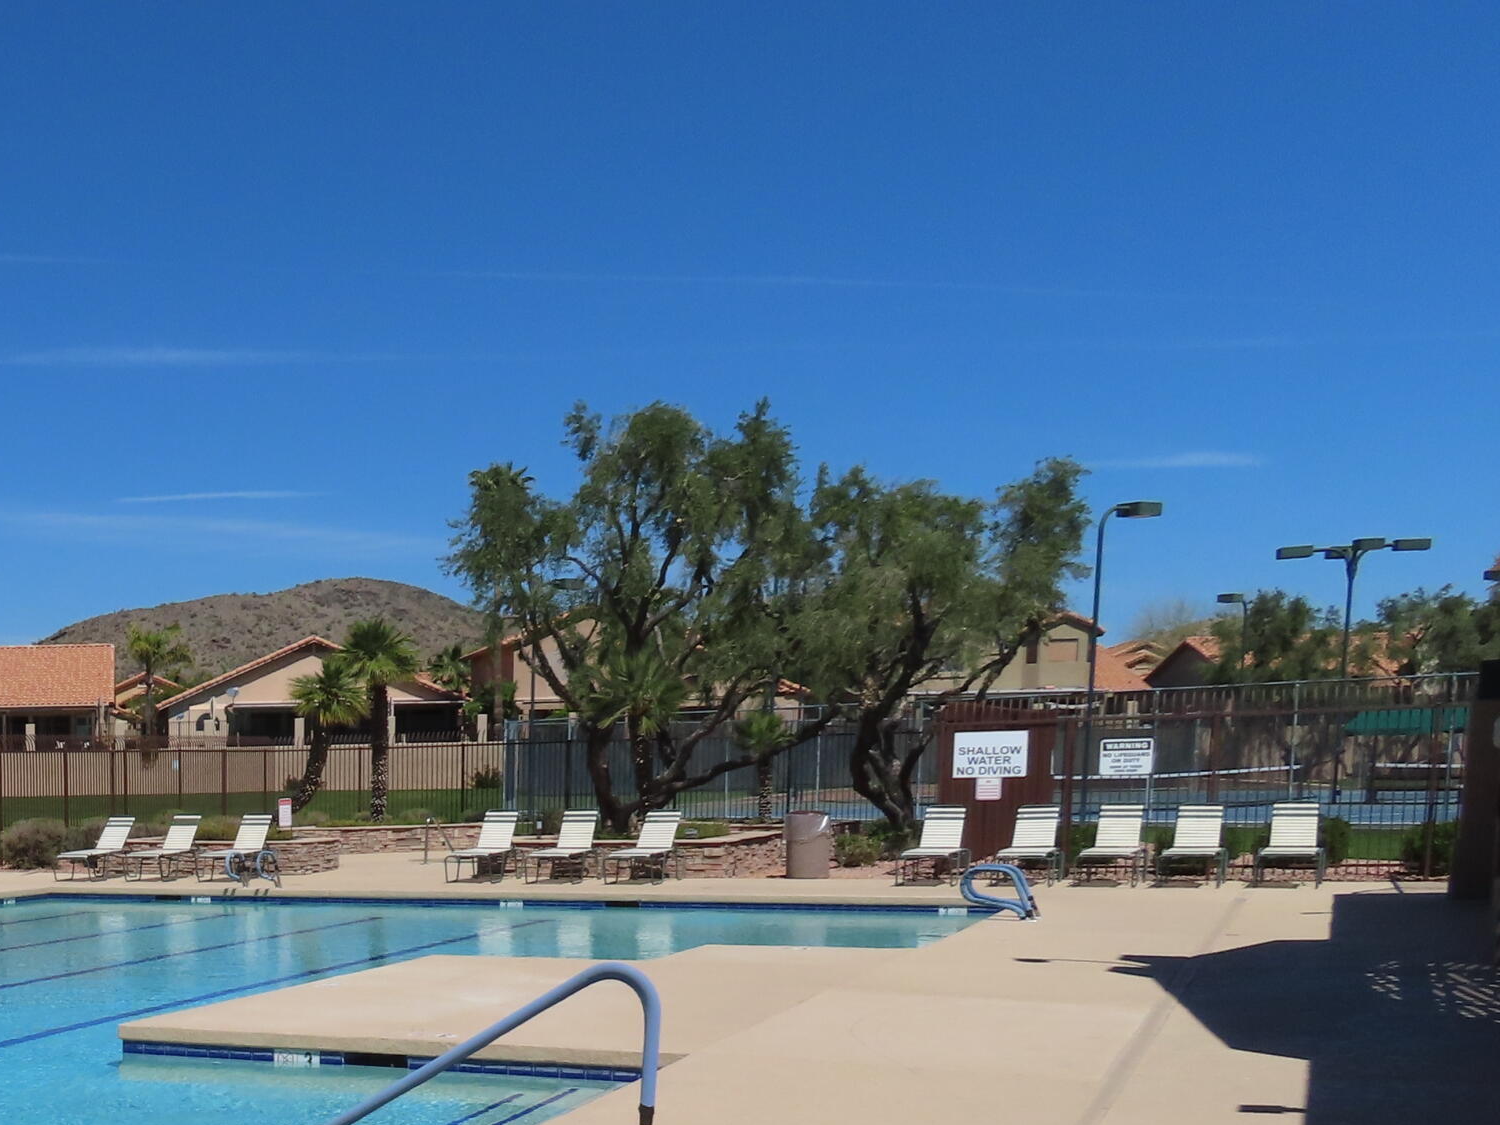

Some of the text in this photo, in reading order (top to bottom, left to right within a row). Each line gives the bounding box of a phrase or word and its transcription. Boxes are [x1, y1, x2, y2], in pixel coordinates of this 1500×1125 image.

[1105, 742, 1149, 750] WARNING
[958, 746, 1022, 756] SHALLOW
[967, 756, 1012, 765] WATER
[956, 766, 1022, 775] NO DIVING
